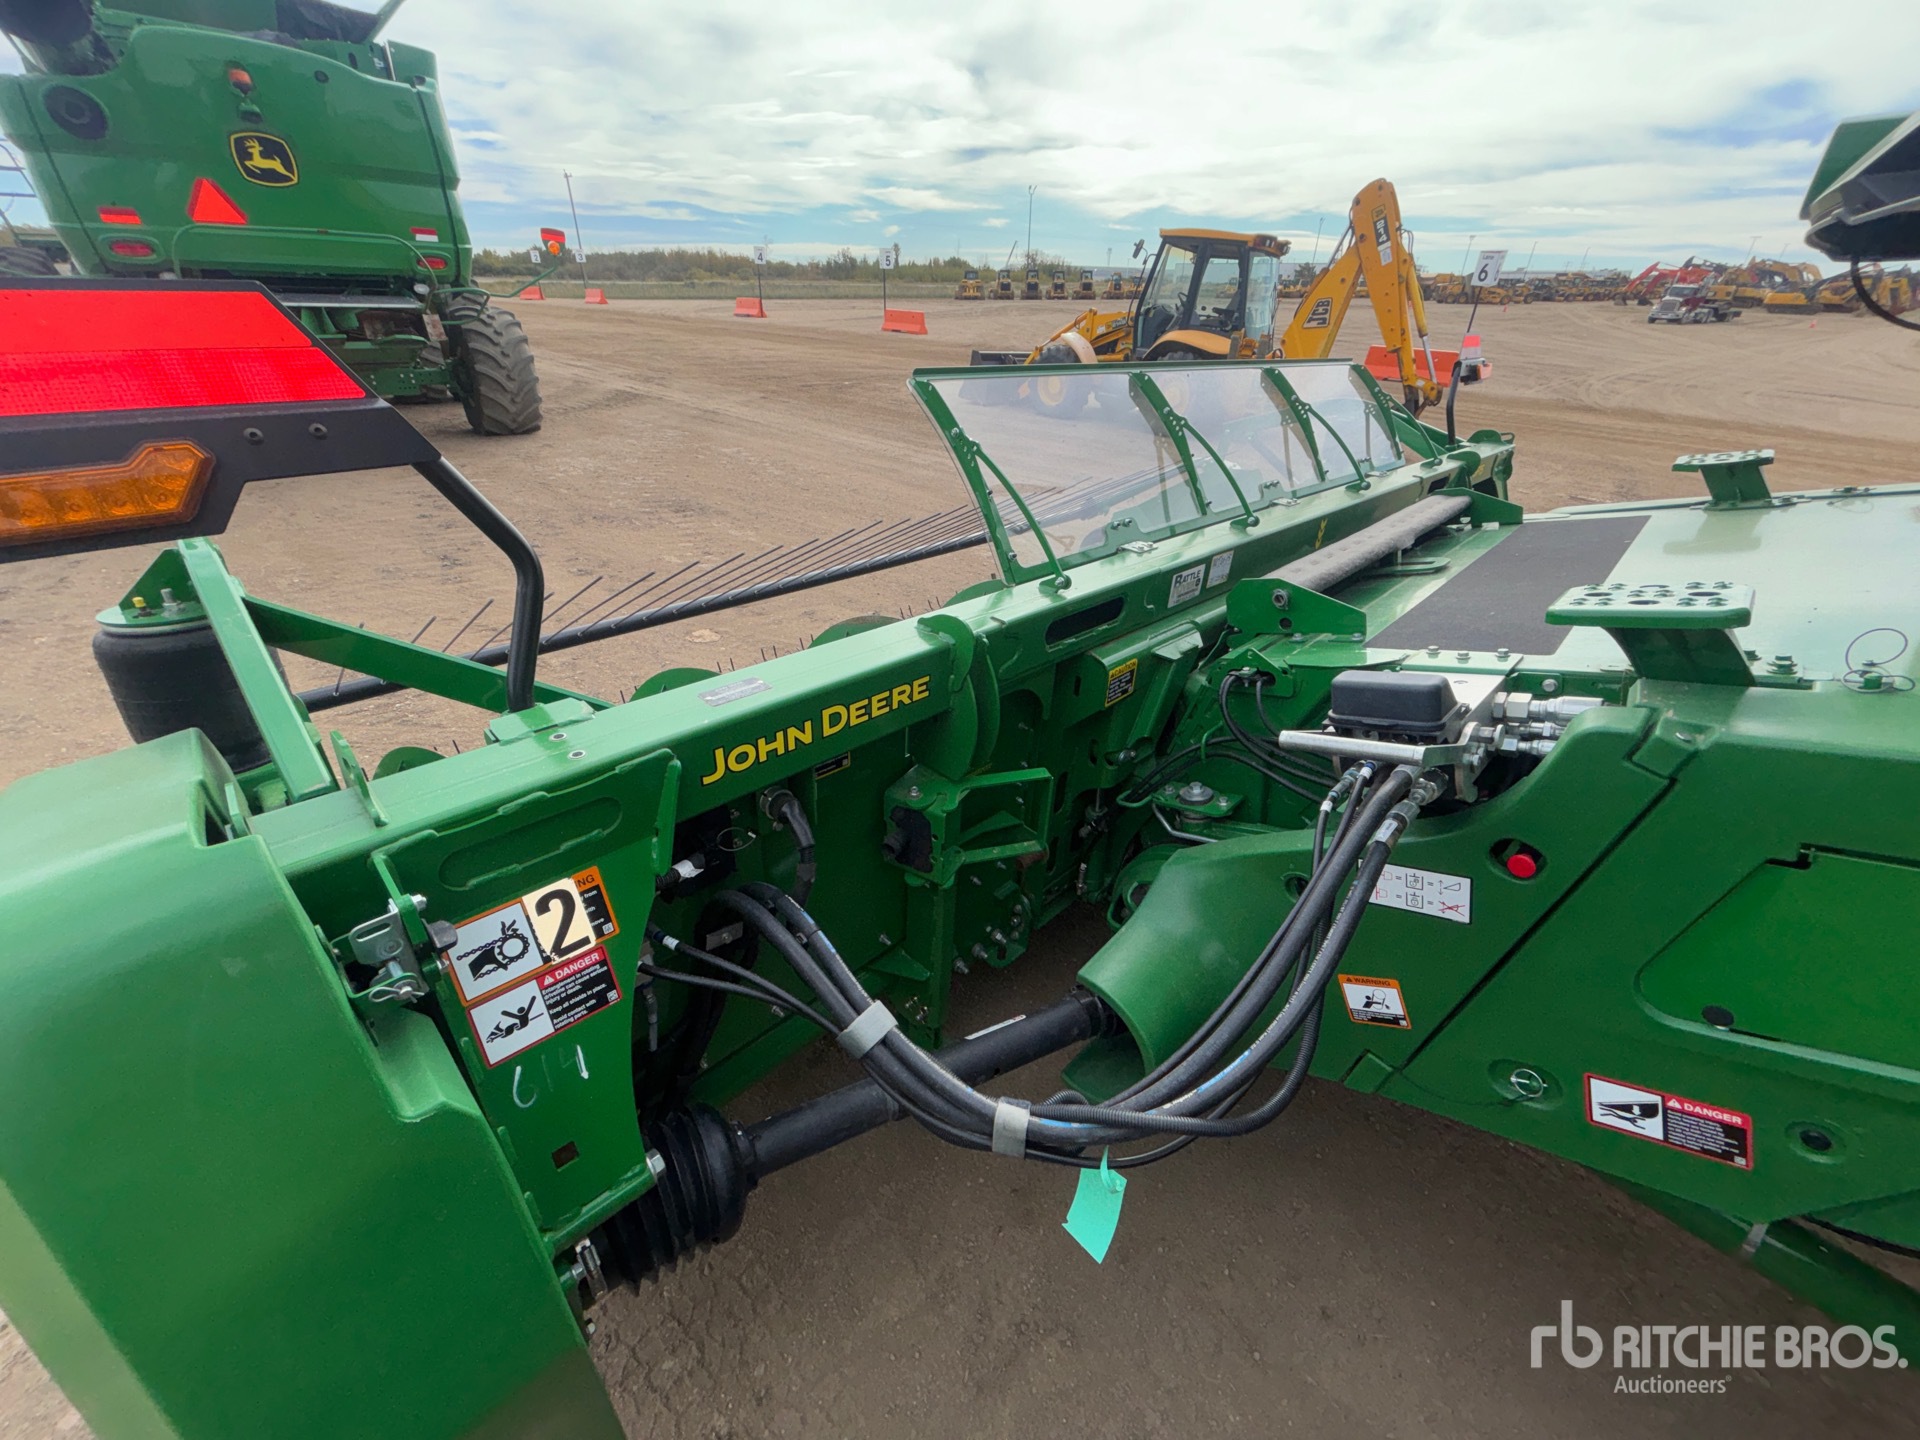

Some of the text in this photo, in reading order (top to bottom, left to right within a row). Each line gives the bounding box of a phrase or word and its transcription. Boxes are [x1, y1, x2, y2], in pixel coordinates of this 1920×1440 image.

[757, 252, 764, 262] 4
[885, 255, 891, 267] 5
[1478, 263, 1489, 282] 6
[1306, 300, 1331, 325] JCB
[702, 719, 813, 786] JOHN
[822, 675, 931, 738] DEERE
[534, 888, 592, 960] 2
[555, 953, 599, 980] DANGER
[1354, 977, 1391, 987] WARNING
[1683, 1102, 1742, 1124] DANGER
